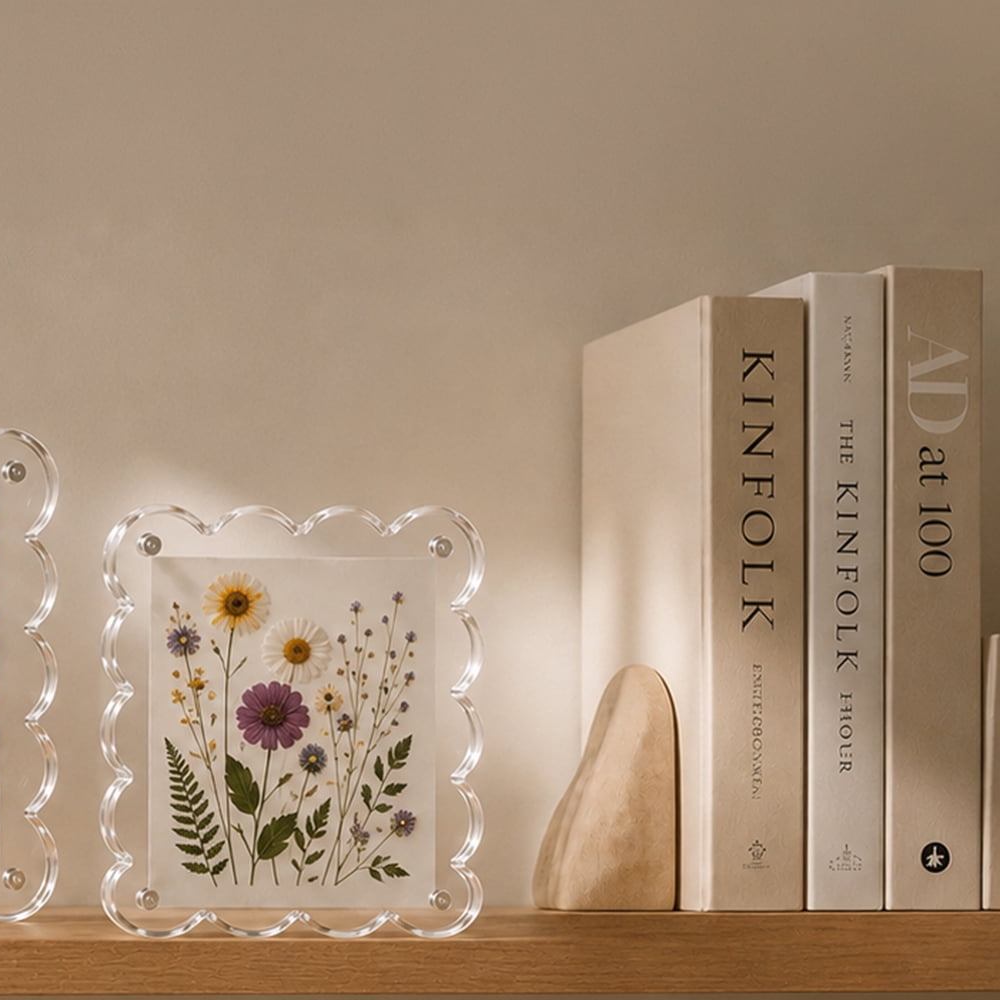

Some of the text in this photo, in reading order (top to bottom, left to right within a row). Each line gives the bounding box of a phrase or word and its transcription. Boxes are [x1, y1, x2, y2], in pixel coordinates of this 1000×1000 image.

[741, 347, 776, 632] KINFOLK
[839, 419, 854, 465] THE
[907, 325, 969, 578] AD at 100
[835, 480, 860, 673] KINFOLK
